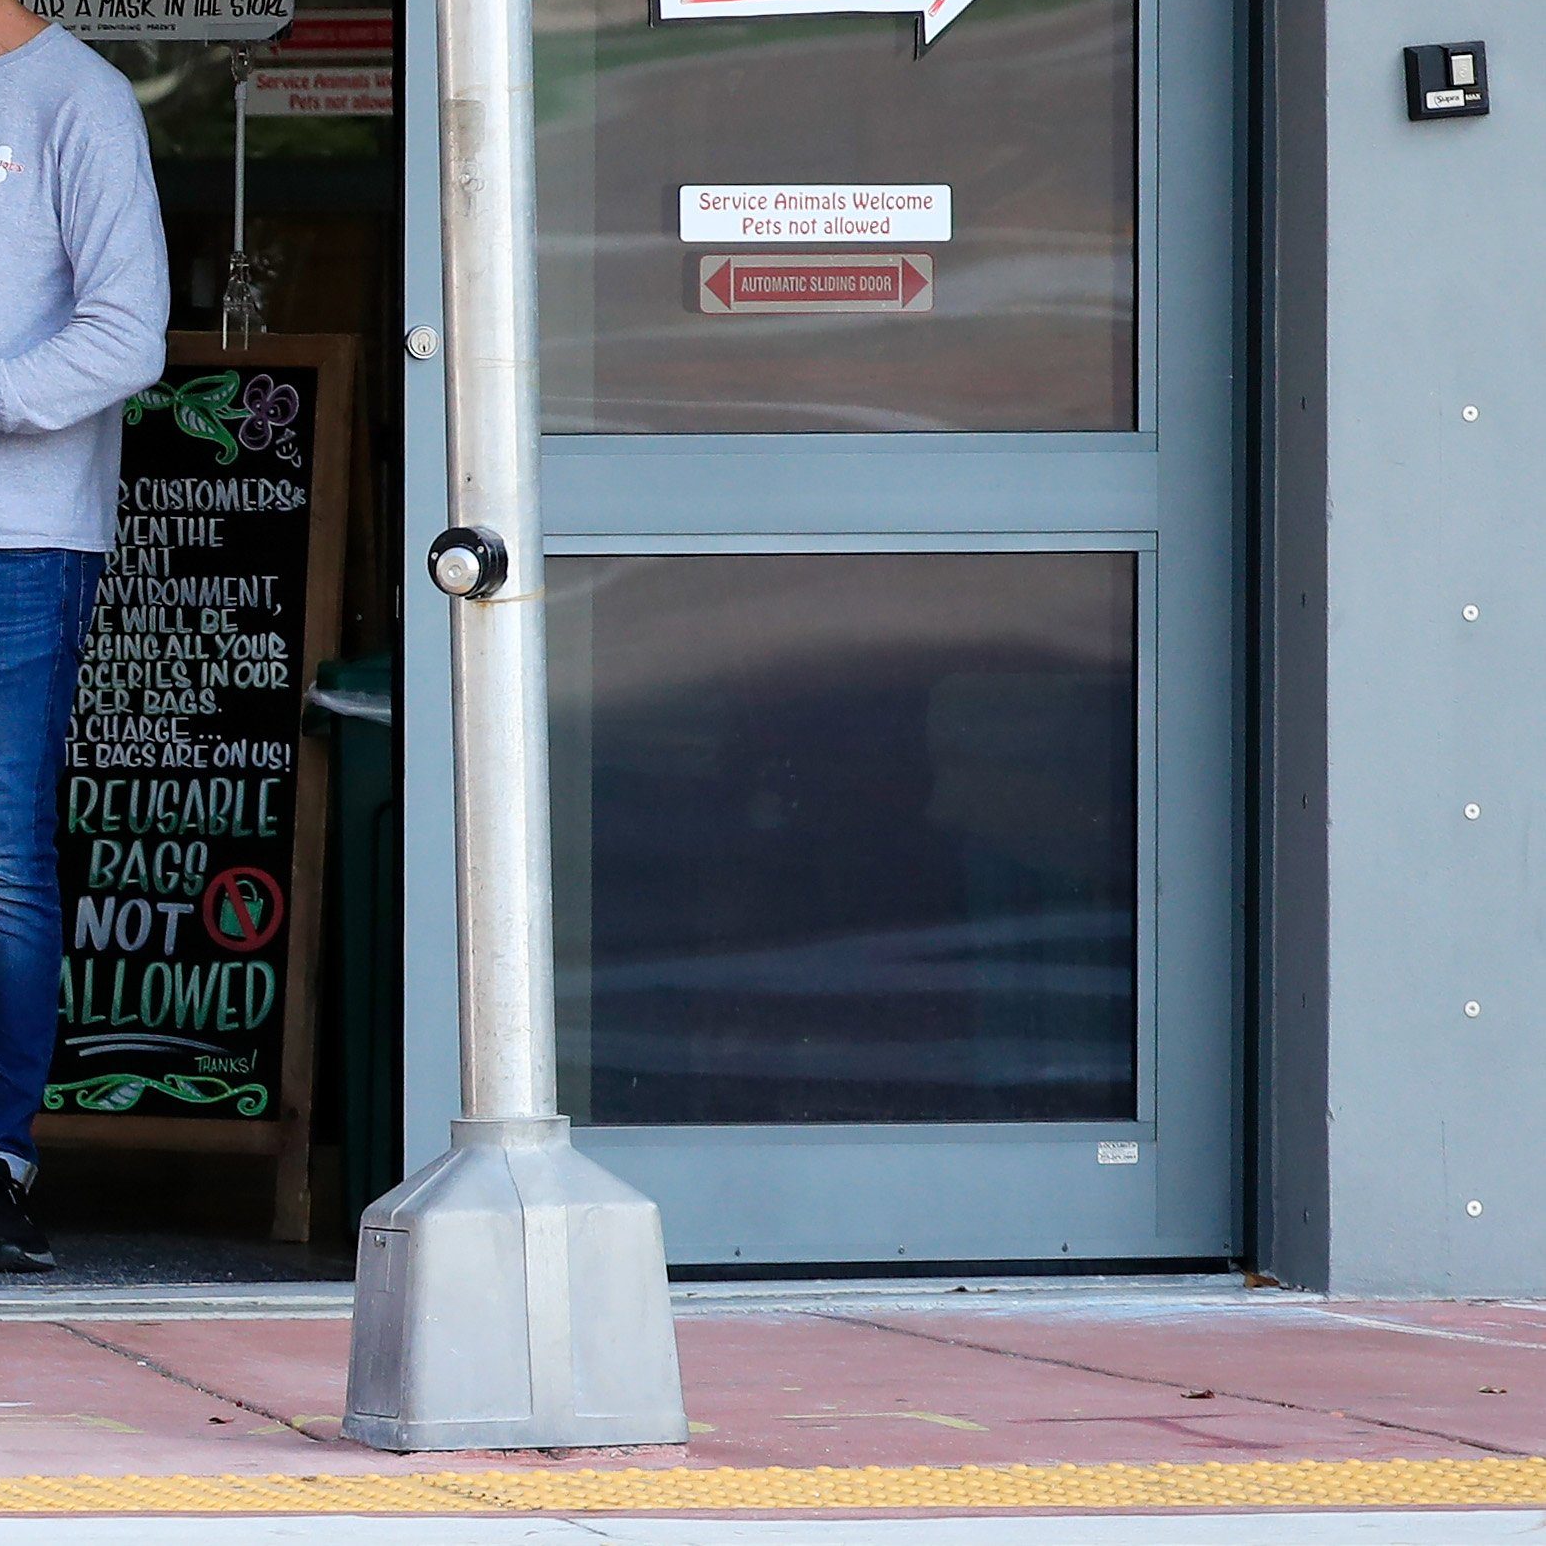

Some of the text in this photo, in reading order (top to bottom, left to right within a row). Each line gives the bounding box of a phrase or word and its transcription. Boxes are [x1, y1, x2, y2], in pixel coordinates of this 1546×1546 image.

[699, 192, 934, 211] Service Animals Welcome
[742, 216, 891, 235] Pets not allowed
[741, 275, 892, 293] AUTOMATIC SLIDING DOOR
[167, 516, 224, 547] THE
[121, 607, 195, 635] WILL
[200, 608, 239, 634] BE
[165, 636, 210, 661] ALL
[215, 633, 289, 661] YOUR
[200, 663, 230, 689] IN
[233, 662, 290, 690] OUR
[86, 716, 190, 742] CHARGE
[96, 743, 156, 768] BAGS
[161, 743, 208, 768] ARE
[213, 740, 246, 769] ON
[253, 742, 292, 772] US!
[68, 776, 282, 837] REUSABLE
[89, 839, 208, 895] BAGS
[74, 896, 195, 955] NOT
[59, 955, 276, 1031] ALLOWED
[194, 1049, 258, 1074] THANKS!
